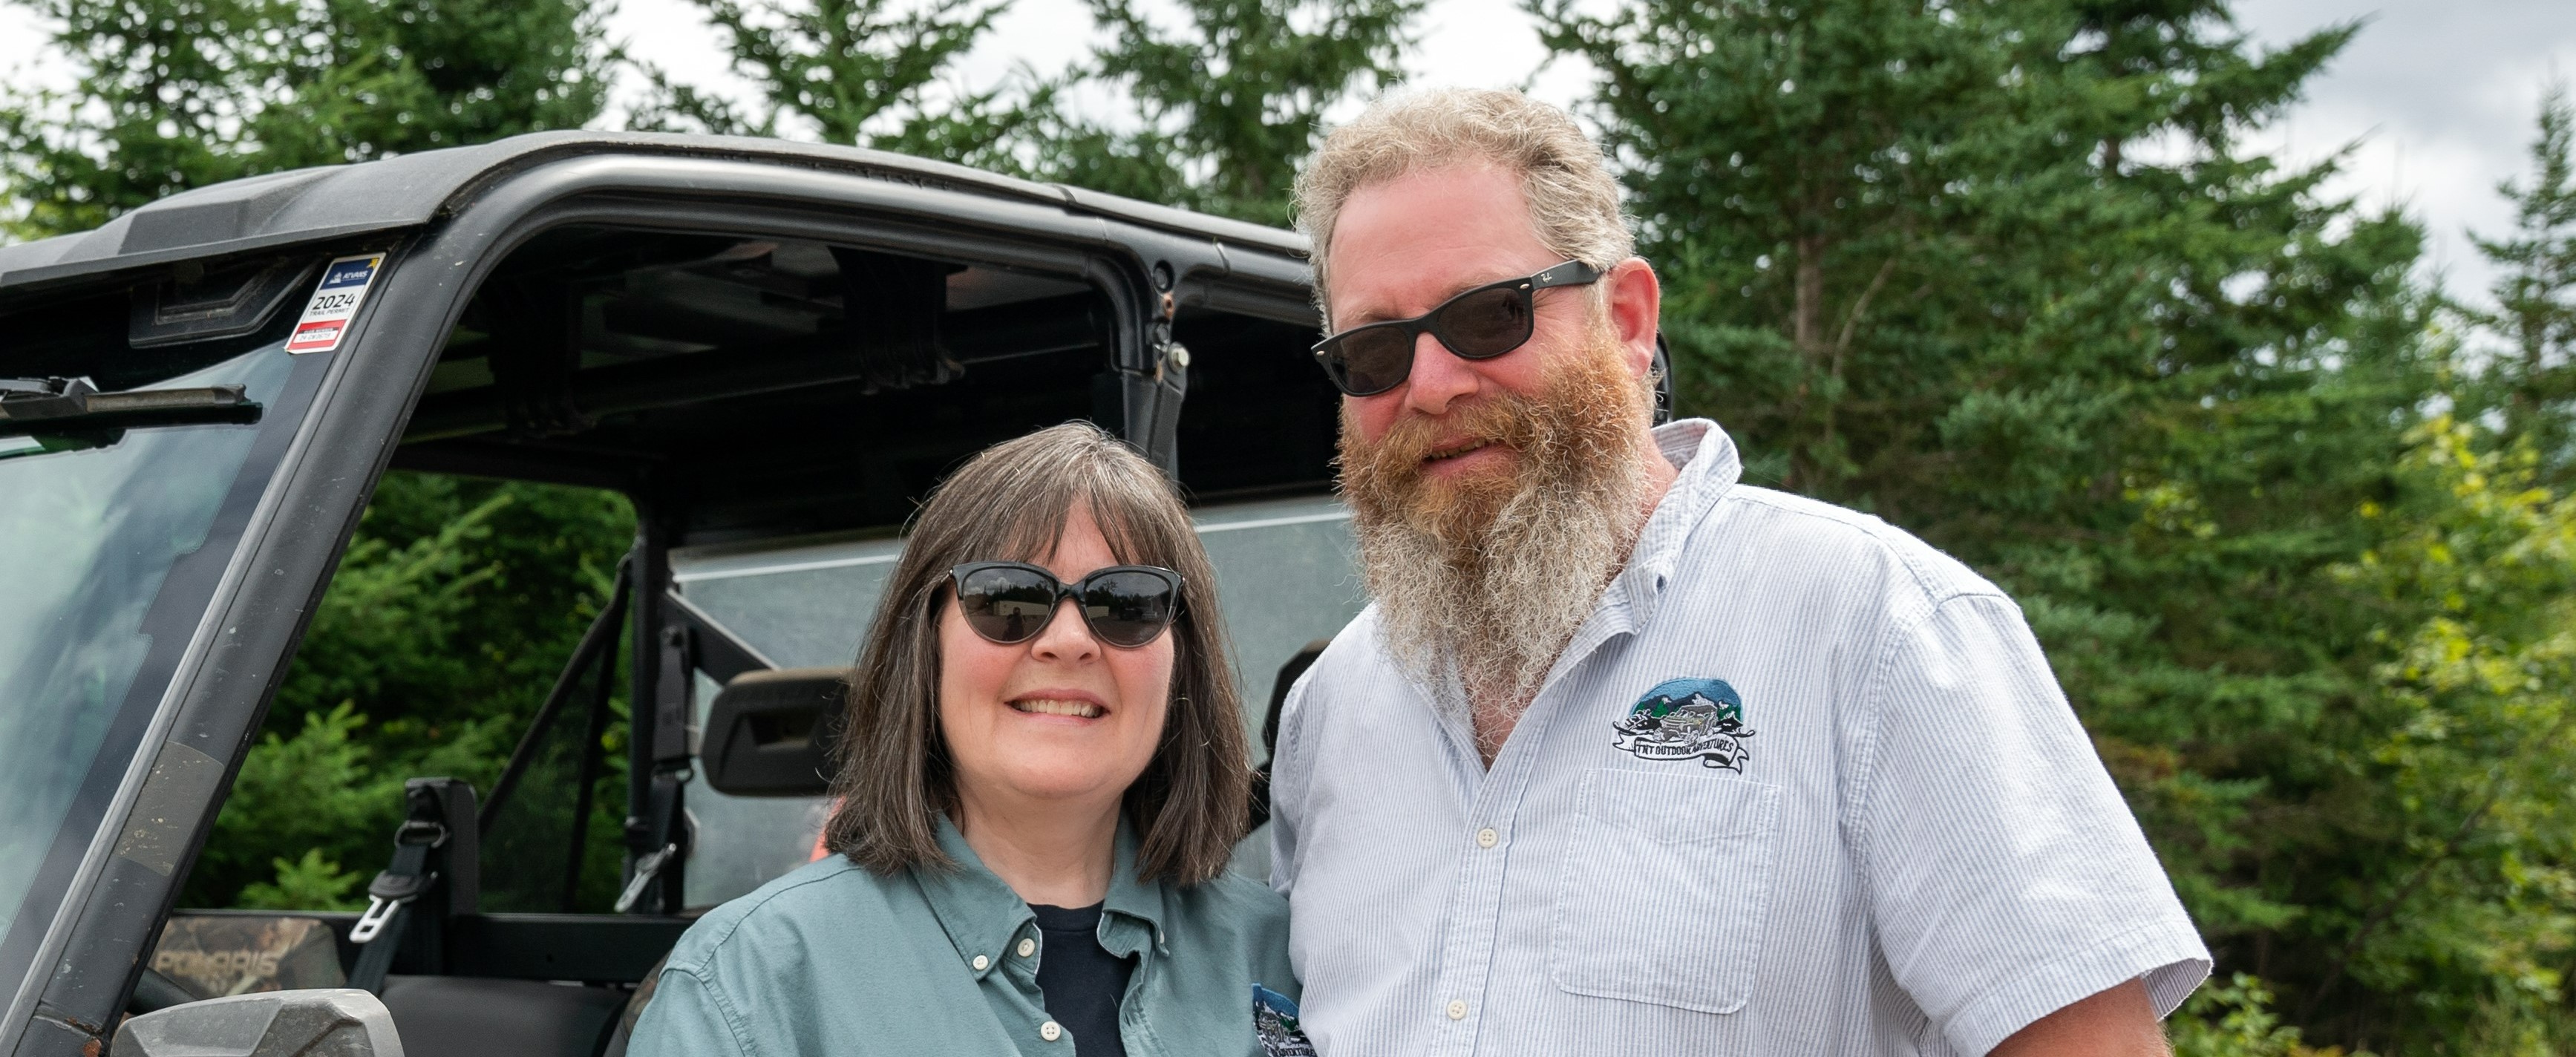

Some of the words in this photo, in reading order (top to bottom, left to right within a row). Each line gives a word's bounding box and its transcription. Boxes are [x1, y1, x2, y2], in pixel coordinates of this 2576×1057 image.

[313, 294, 355, 310] 2024
[1635, 745, 1655, 755] TNT
[154, 949, 278, 978] POLARIS
